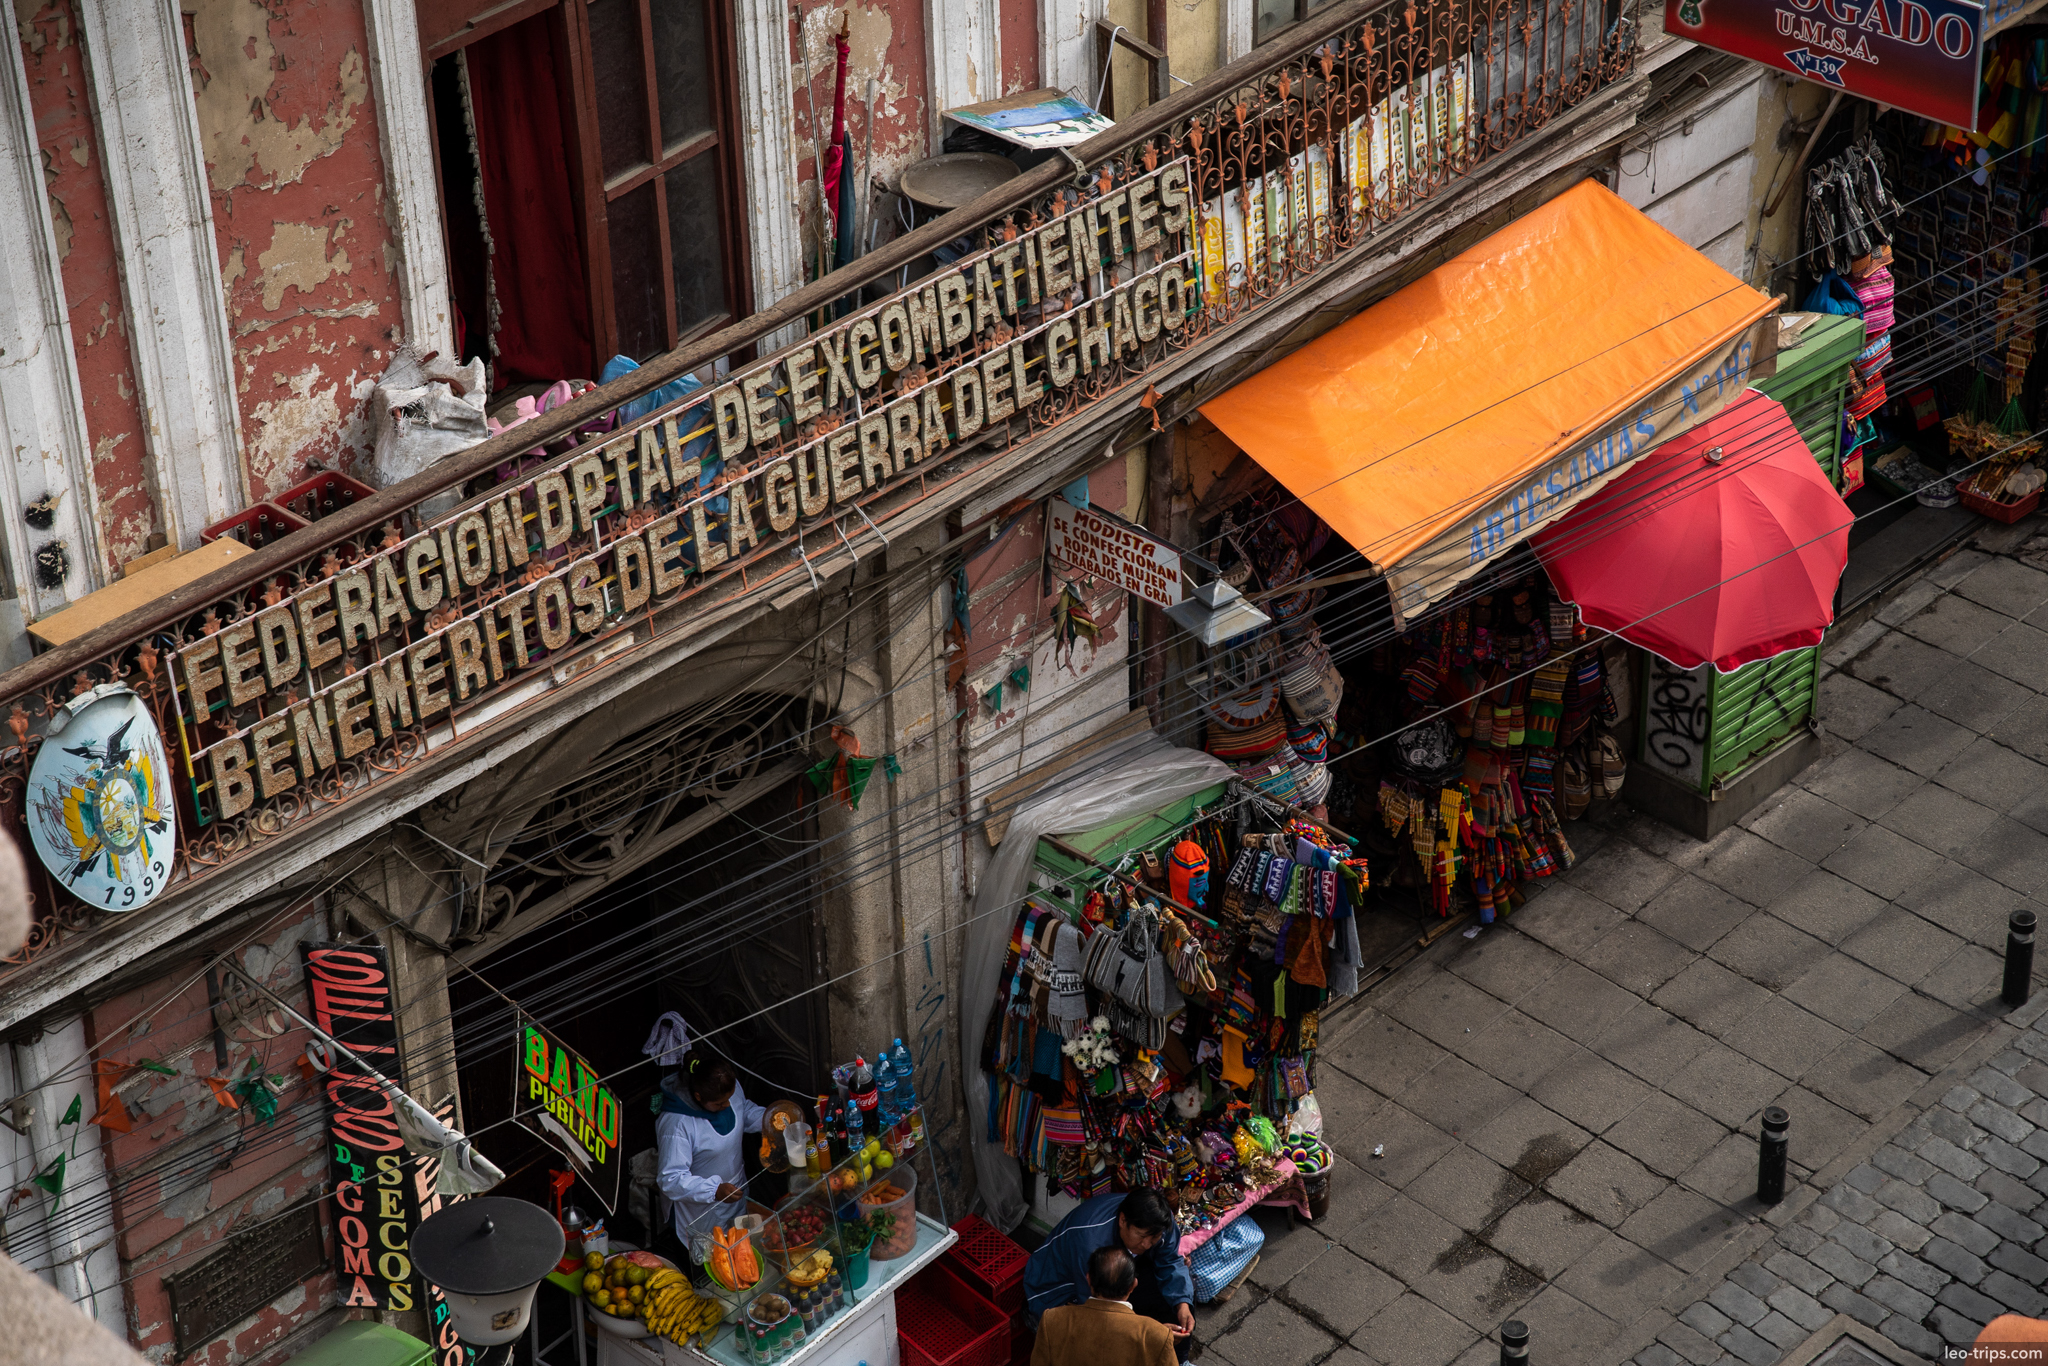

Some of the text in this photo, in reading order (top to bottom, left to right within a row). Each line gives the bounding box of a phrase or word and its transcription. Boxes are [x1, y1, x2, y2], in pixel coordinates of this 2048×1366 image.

[1775, 8, 1879, 65] U.M.S.A.
[1788, 0, 1974, 59] GADO
[1815, 59, 1836, 75] 139
[1314, 160, 1322, 191] HIELO
[1225, 222, 1236, 259] SIRVE
[180, 488, 529, 724] FEDERACION
[533, 412, 701, 551] DPTAL
[710, 367, 781, 461] DE
[783, 162, 1190, 426] EXCOMBATIENTES
[1468, 406, 1656, 566] ARTESANIAS
[1714, 340, 1752, 396] 143
[208, 263, 1187, 820] BENEMERITOS DE LA GUERRA DEL CHACO
[1053, 516, 1178, 583] SE CONFECCIONAN
[1063, 534, 1167, 592] ROPA DE MUJER
[1073, 509, 1157, 559] MODISTA
[1054, 543, 1063, 559] Y
[1065, 549, 1122, 585] TRABAJOS
[1125, 575, 1140, 593] EN
[104, 860, 165, 907] 1999
[307, 948, 405, 1153] SELLOS
[524, 1021, 618, 1149] BAÑO
[530, 1075, 606, 1164] PUBLICO
[334, 1143, 378, 1308] DE GOMA
[375, 1154, 414, 1312] SECOS
